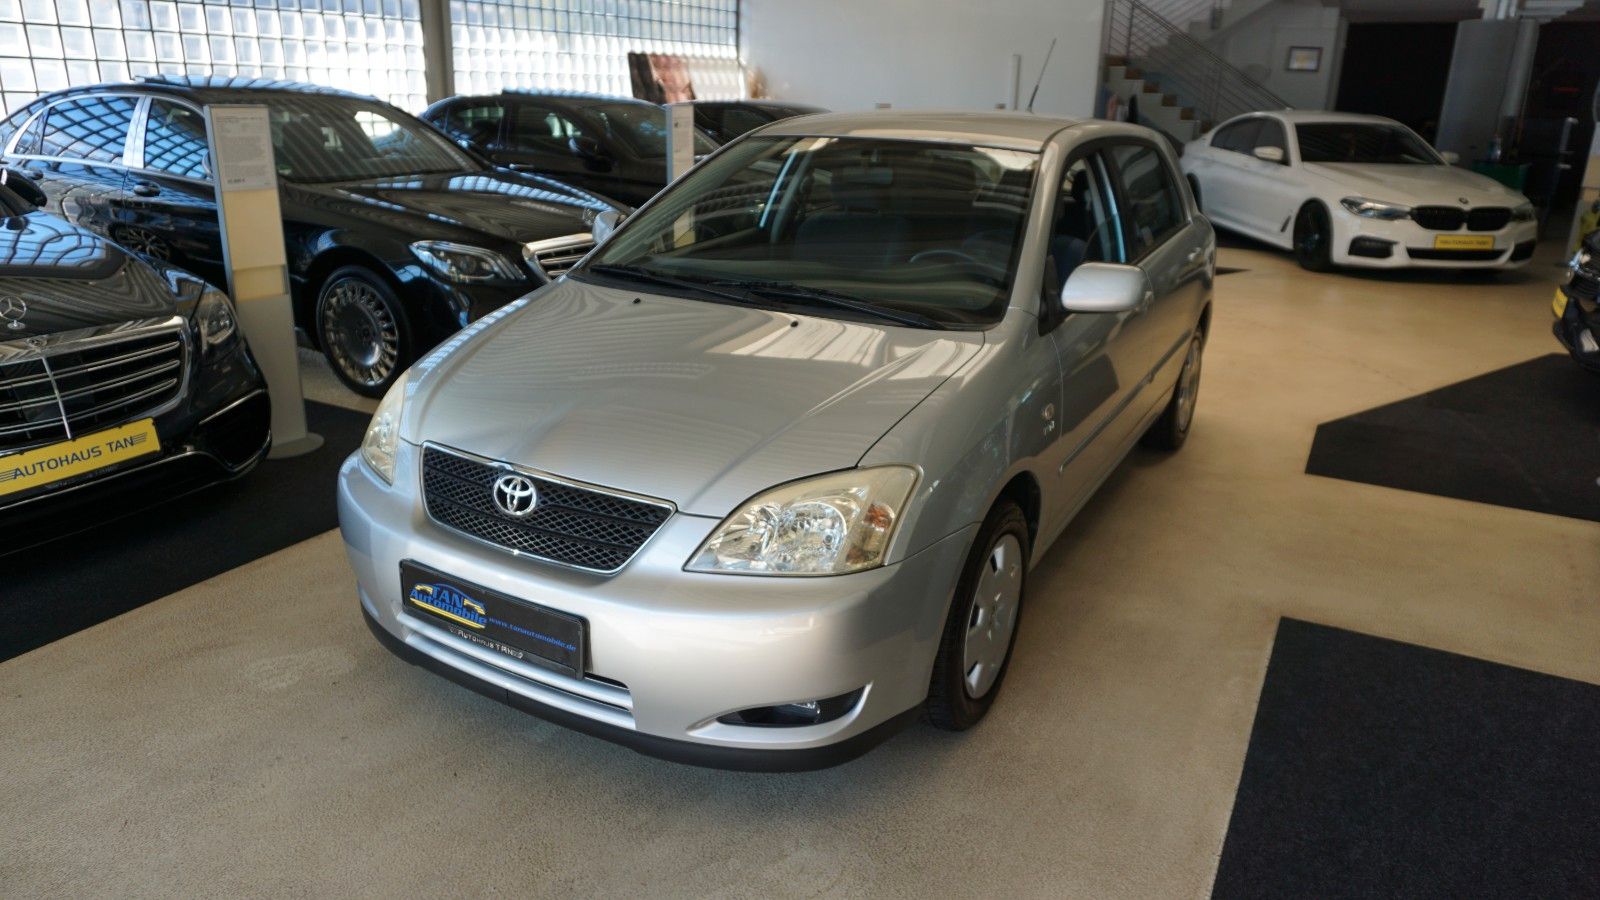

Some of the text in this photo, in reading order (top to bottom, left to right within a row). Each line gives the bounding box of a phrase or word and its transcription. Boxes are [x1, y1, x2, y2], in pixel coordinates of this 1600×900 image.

[13, 445, 103, 480] AUTOHAUS
[106, 435, 135, 454] TAN
[410, 589, 488, 626] Automobile
[431, 585, 465, 609] TAN
[489, 617, 577, 651] www.tanautomobile.de
